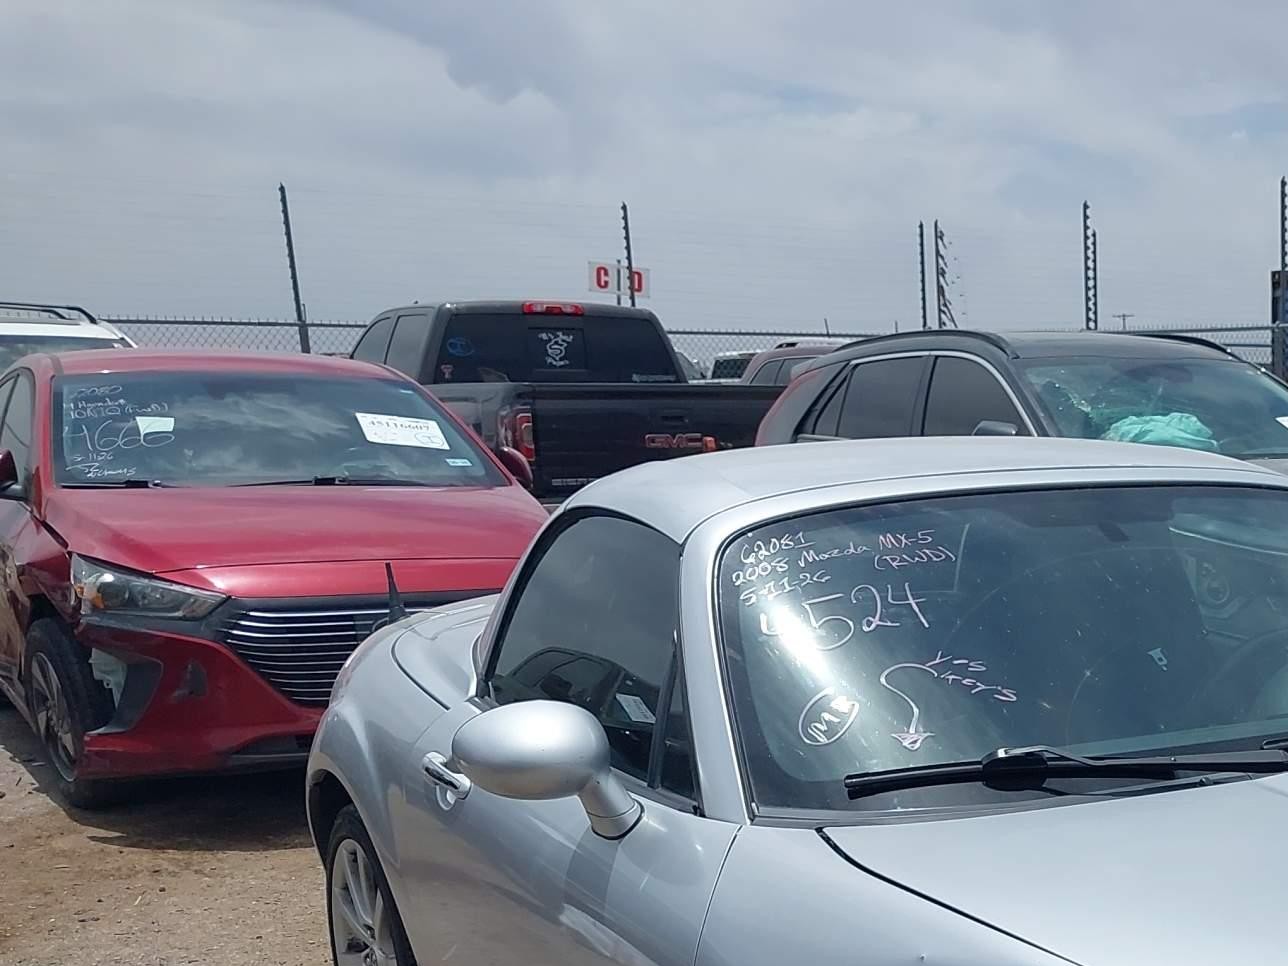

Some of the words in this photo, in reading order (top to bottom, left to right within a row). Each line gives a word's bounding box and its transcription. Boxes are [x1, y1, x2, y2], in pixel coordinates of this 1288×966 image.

[596, 266, 608, 289] C
[645, 433, 703, 449] GMC
[798, 541, 870, 568] Mazda
[879, 529, 936, 550] MX-5
[874, 546, 955, 570] (RWD)
